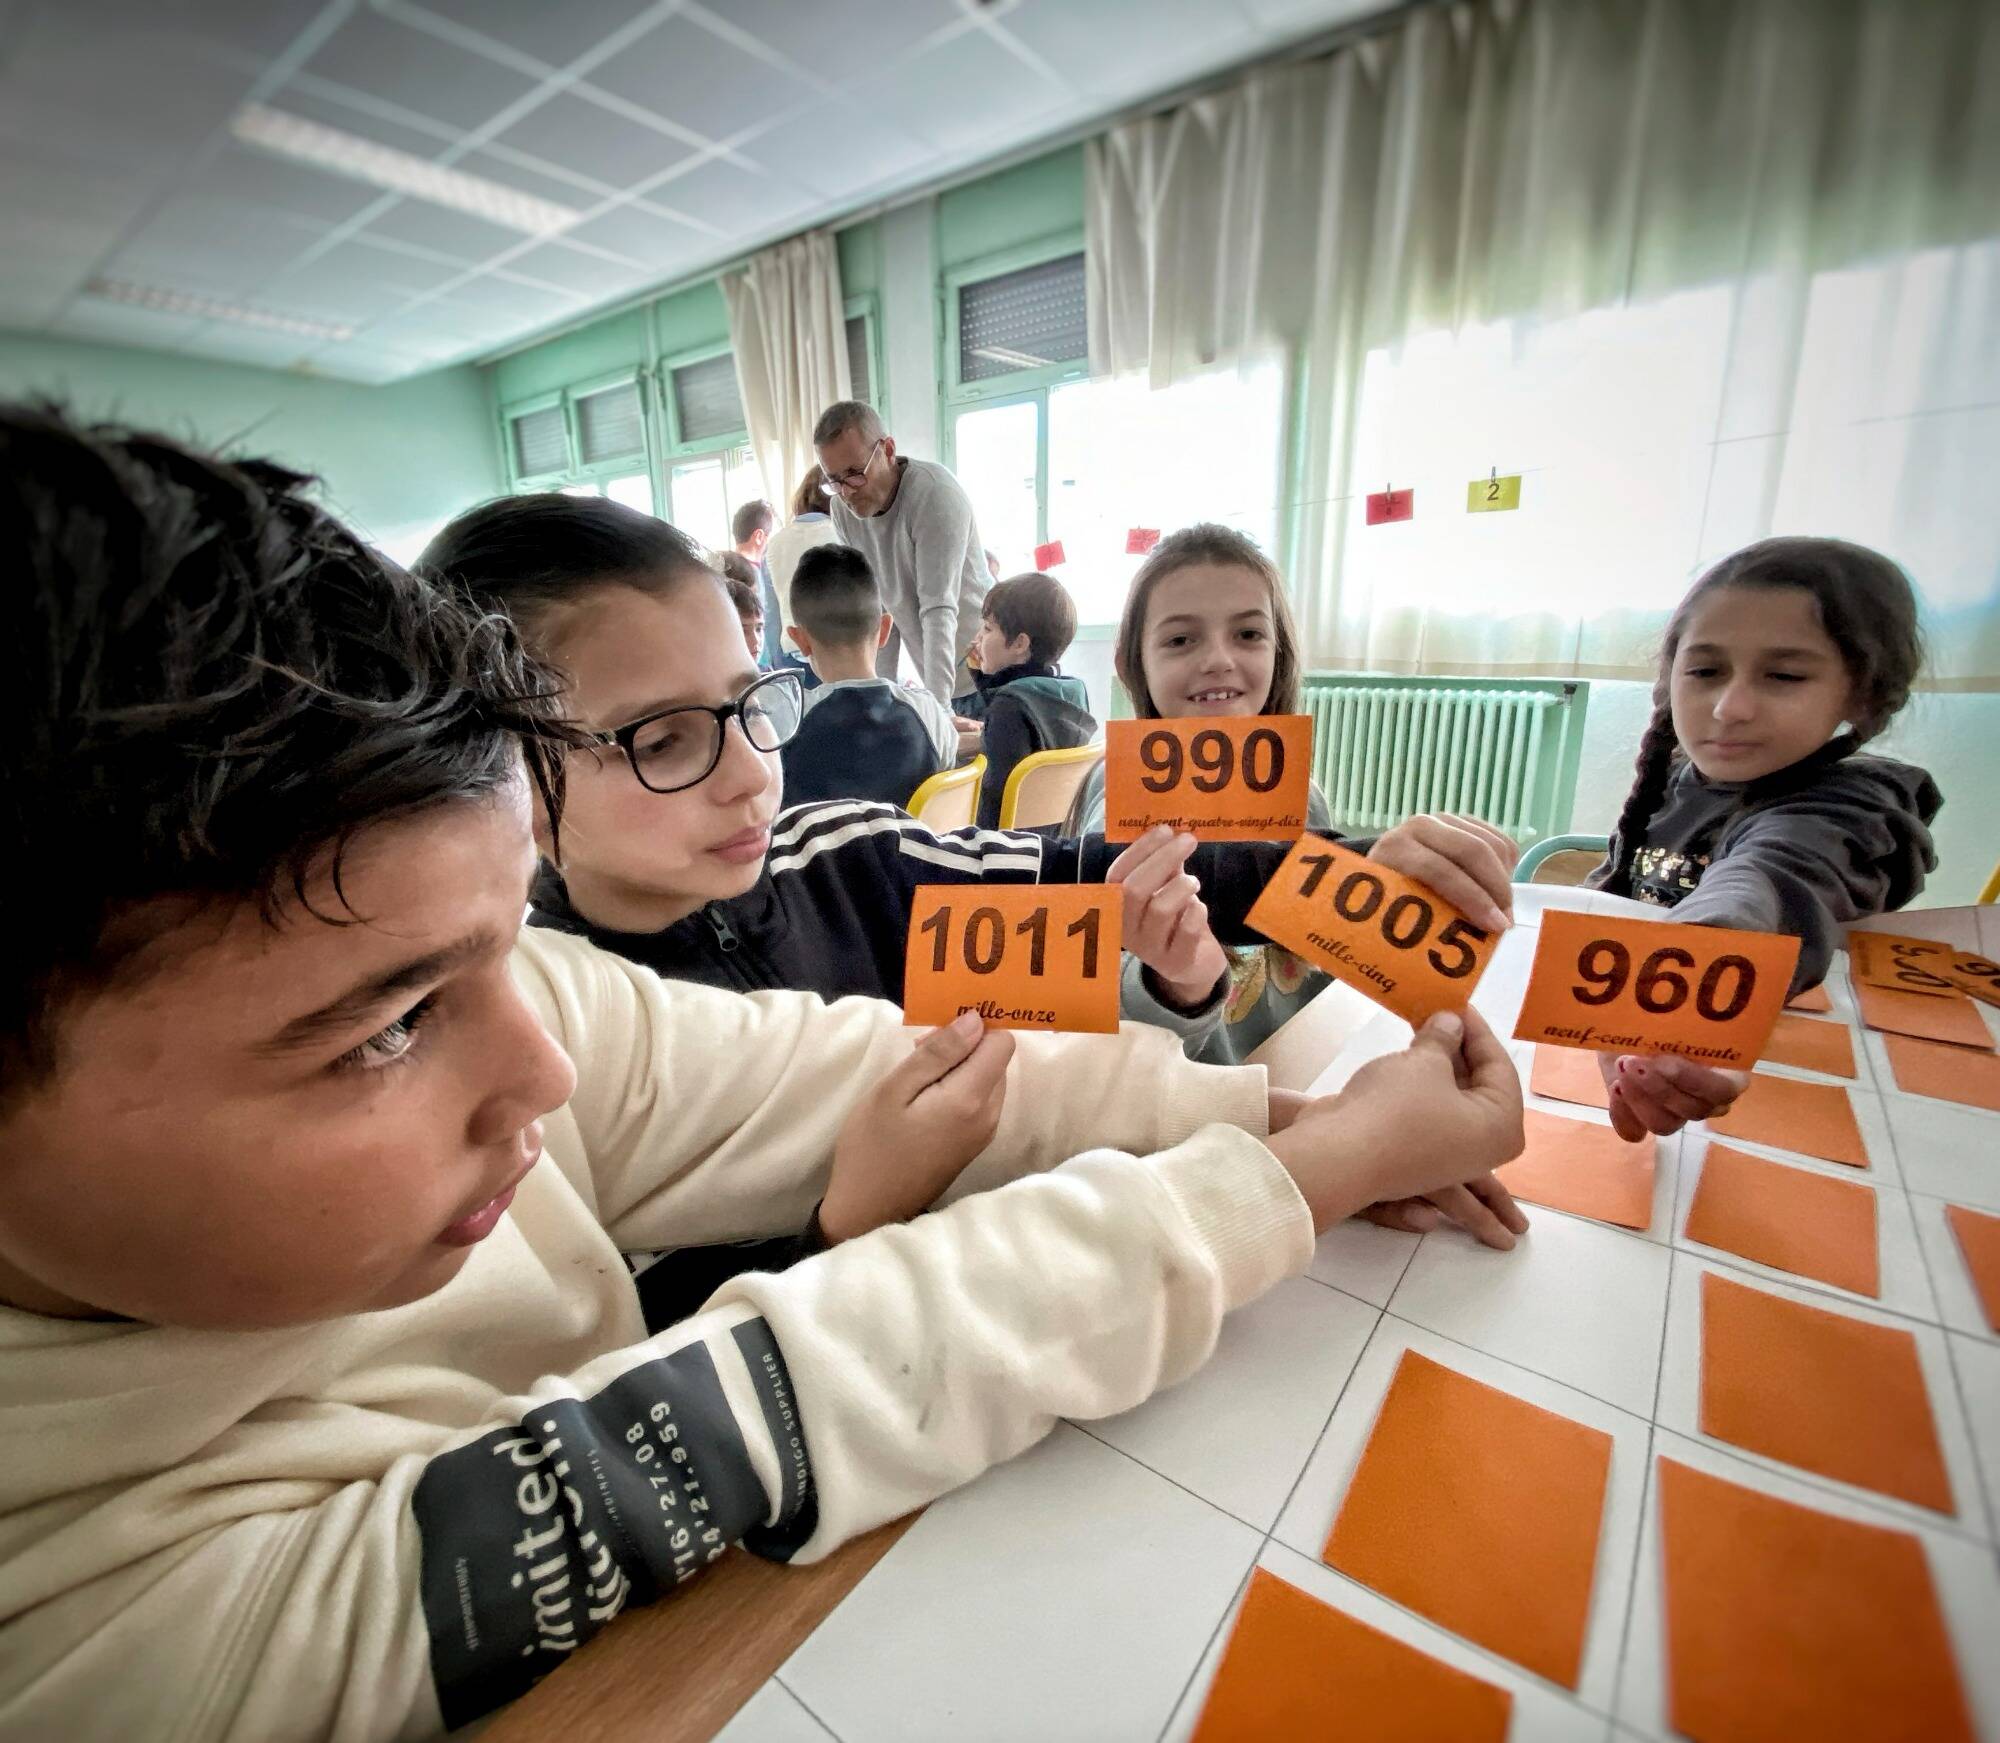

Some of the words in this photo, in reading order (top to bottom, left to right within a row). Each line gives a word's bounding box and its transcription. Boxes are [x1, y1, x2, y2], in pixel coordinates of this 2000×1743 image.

[1486, 483, 1500, 501] 2
[1139, 728, 1285, 793] 990
[920, 905, 1101, 979] 1011
[1299, 854, 1488, 979] 1005
[1306, 932, 1397, 993] mille-cinq
[1572, 938, 1756, 1022] 960
[1543, 1025, 1742, 1061] neuf-cent-soixante
[762, 1352, 796, 1431] SUPPLIER
